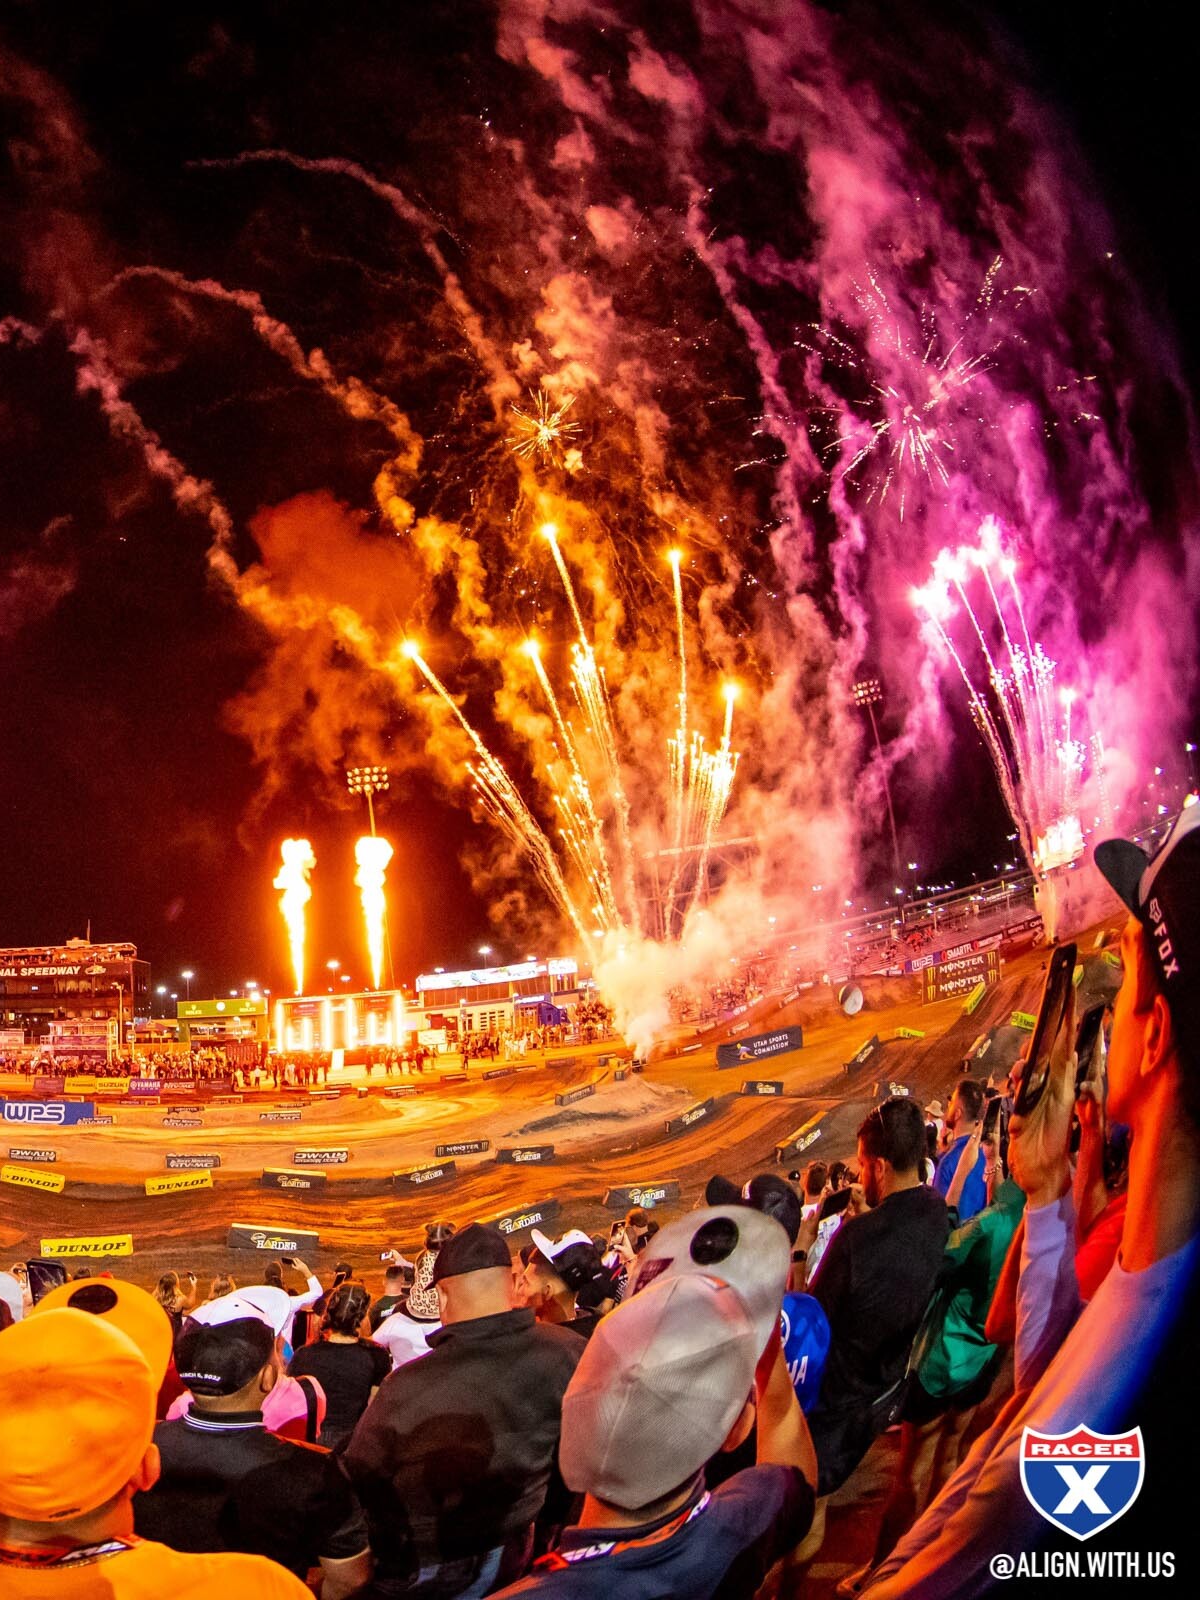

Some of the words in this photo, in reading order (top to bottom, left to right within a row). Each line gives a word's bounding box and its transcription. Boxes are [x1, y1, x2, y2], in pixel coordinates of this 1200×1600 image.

[1154, 922, 1179, 979] FOX
[911, 954, 934, 972] WPS
[939, 956, 984, 974] MONSTER
[20, 966, 81, 976] SPEEDWAY
[939, 974, 985, 992] MONSTER
[753, 1039, 768, 1049] UTAH
[769, 1033, 789, 1045] SPORTS
[754, 1041, 789, 1056] COMMISSION
[4, 1103, 65, 1125] WPS
[446, 1143, 479, 1152] MONSTER
[11, 1174, 59, 1188] DUNLOP
[157, 1178, 209, 1191] DUNLOP
[505, 1213, 542, 1234] HARDER
[57, 1242, 126, 1254] DUNLOP
[256, 1240, 297, 1250] HARDER
